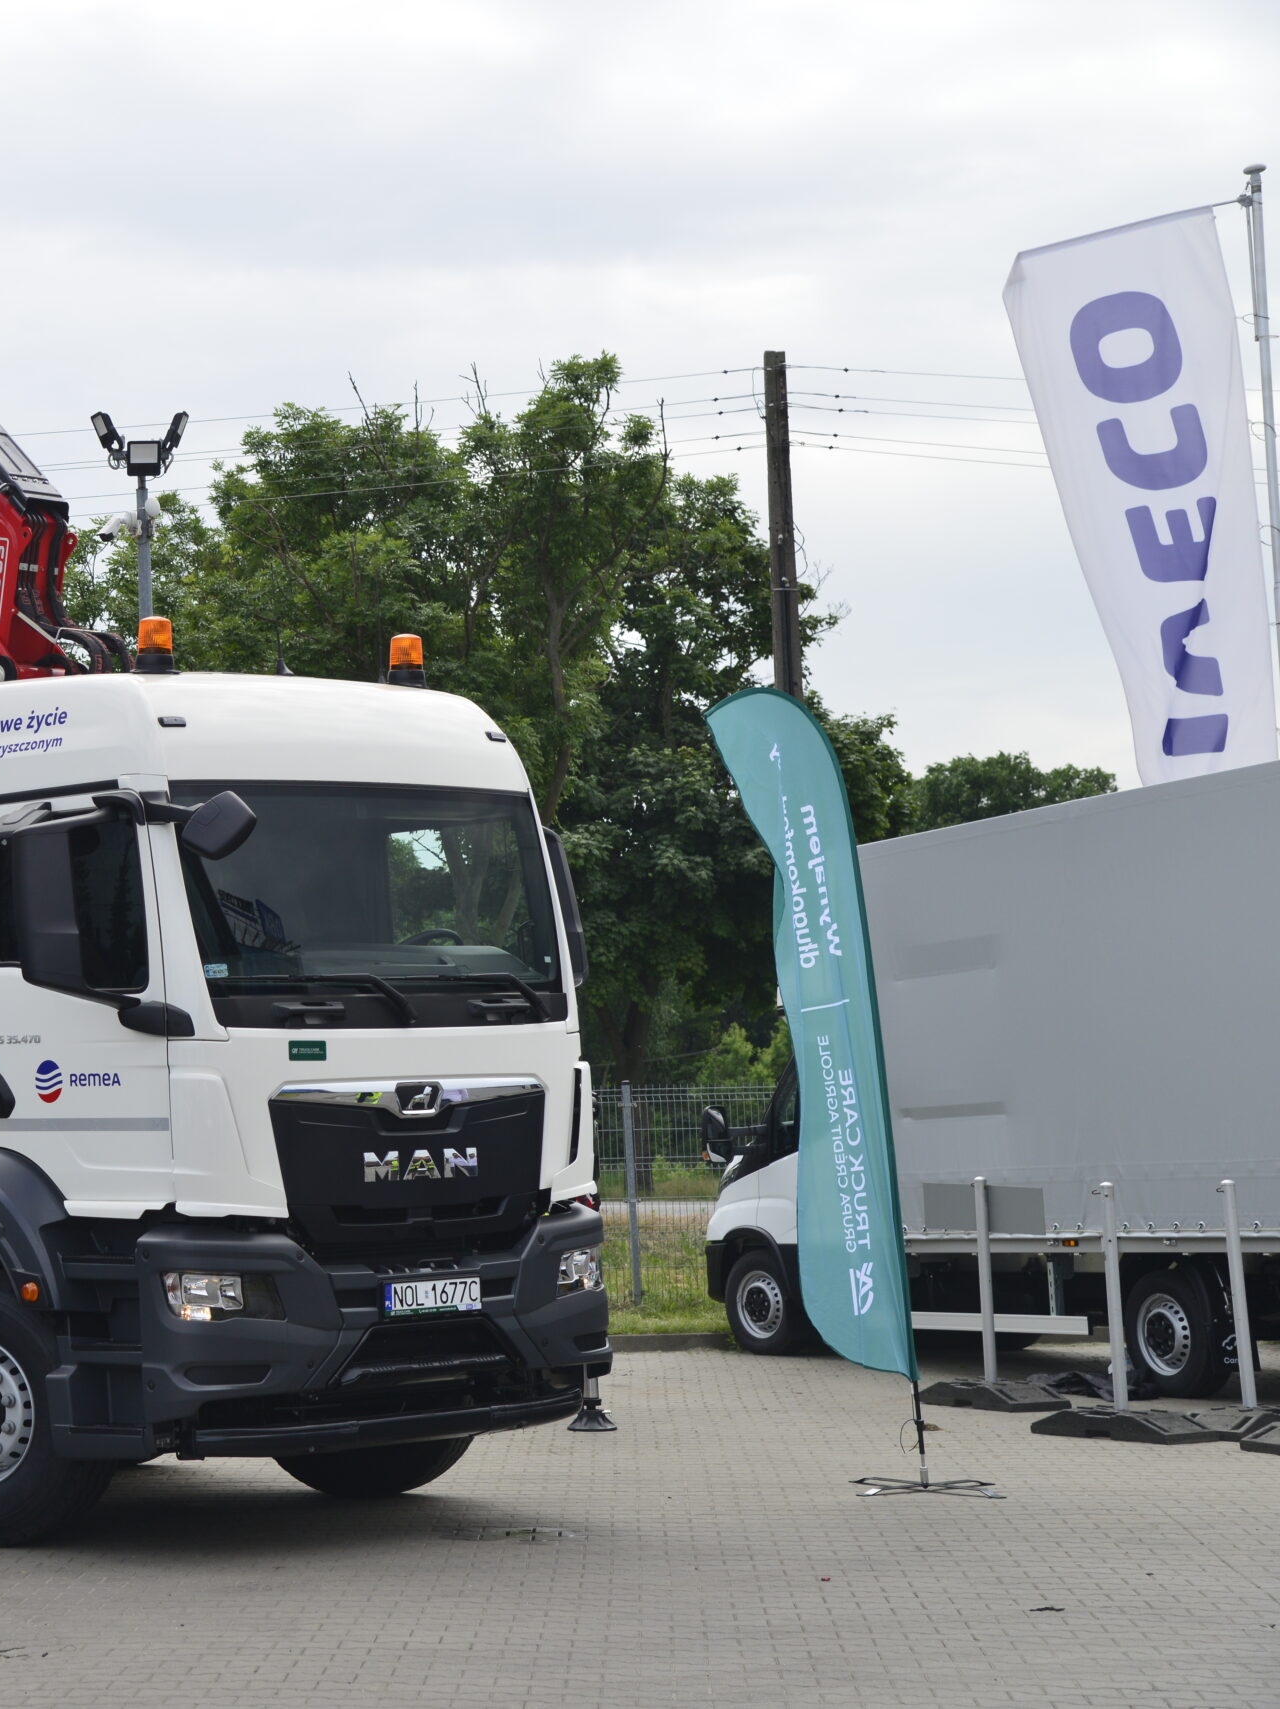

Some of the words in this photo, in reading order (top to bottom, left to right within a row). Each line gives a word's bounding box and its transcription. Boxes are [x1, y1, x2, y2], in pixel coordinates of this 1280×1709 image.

[26, 706, 68, 734] życie
[363, 1146, 479, 1183] MAN
[393, 1284, 425, 1309] NOL
[431, 1280, 478, 1305] 1677C
